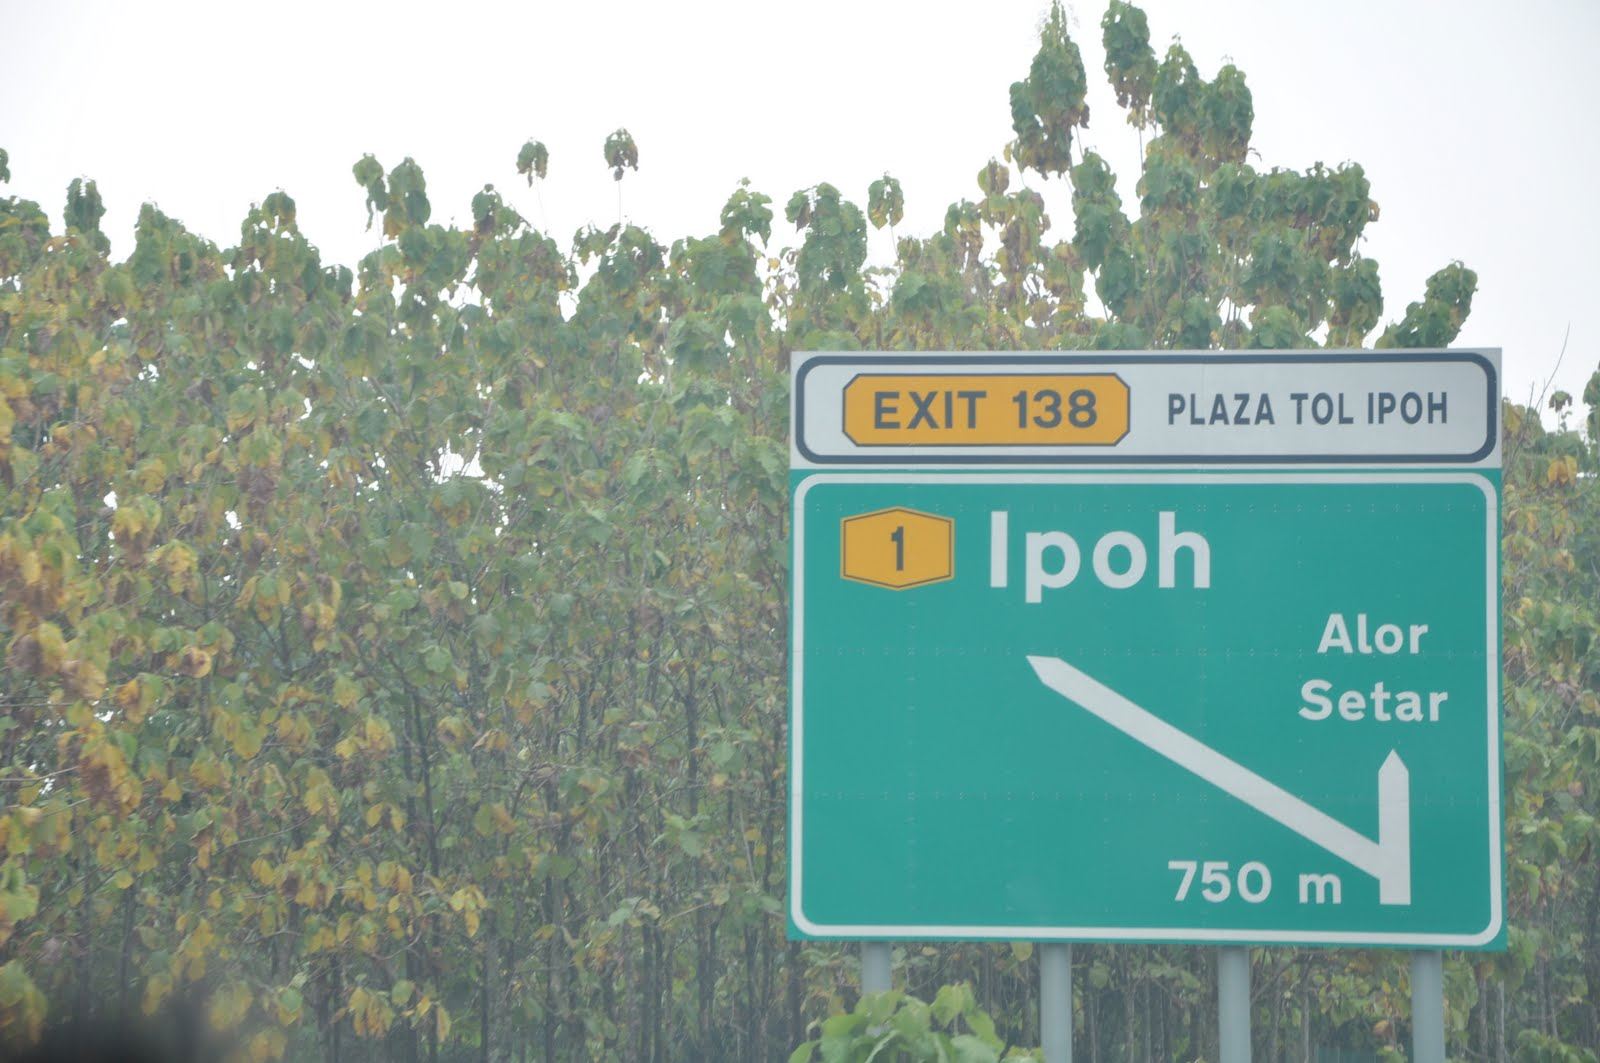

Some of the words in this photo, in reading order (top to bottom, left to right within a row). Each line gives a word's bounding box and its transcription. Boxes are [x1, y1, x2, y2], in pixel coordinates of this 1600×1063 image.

[874, 391, 987, 429] EXIT
[1013, 389, 1097, 428] 138
[1169, 393, 1275, 425] PLAZA
[1290, 393, 1353, 425] TOL
[1368, 392, 1447, 424] IPOH
[891, 526, 904, 571] 1
[991, 511, 1210, 603] Ipoh
[1318, 613, 1428, 654] Alor
[1299, 679, 1448, 721] Setar
[1168, 861, 1271, 903] 750
[1299, 874, 1341, 904] m
